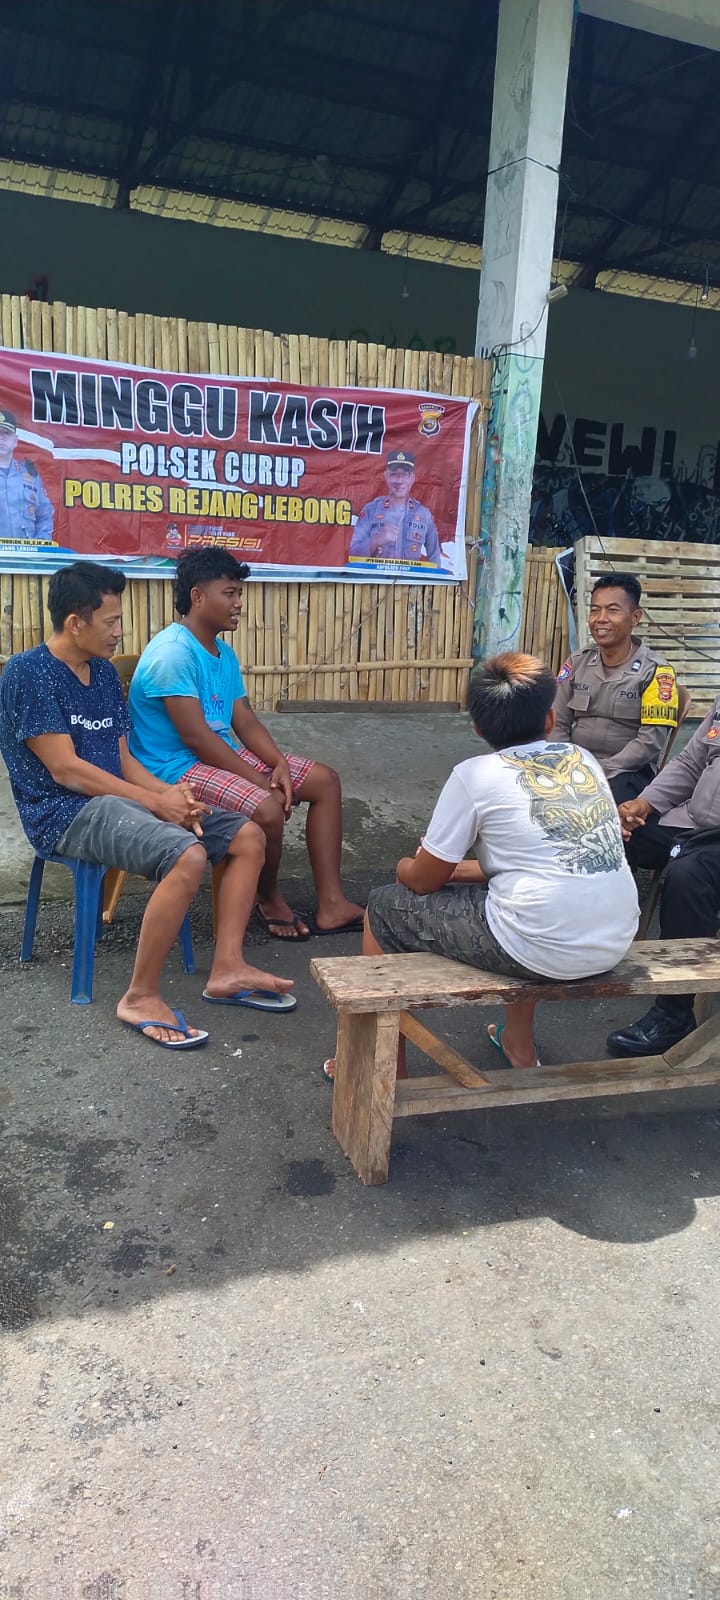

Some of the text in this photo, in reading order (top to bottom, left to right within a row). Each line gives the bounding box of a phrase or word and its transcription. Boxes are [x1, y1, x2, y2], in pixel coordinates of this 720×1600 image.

[30, 368, 386, 455] MINGGU KASIH
[120, 442, 306, 488] POLSEK CURUP
[64, 478, 352, 527] POLRES REJANG LEBONG
[187, 534, 262, 550] PRESISI
